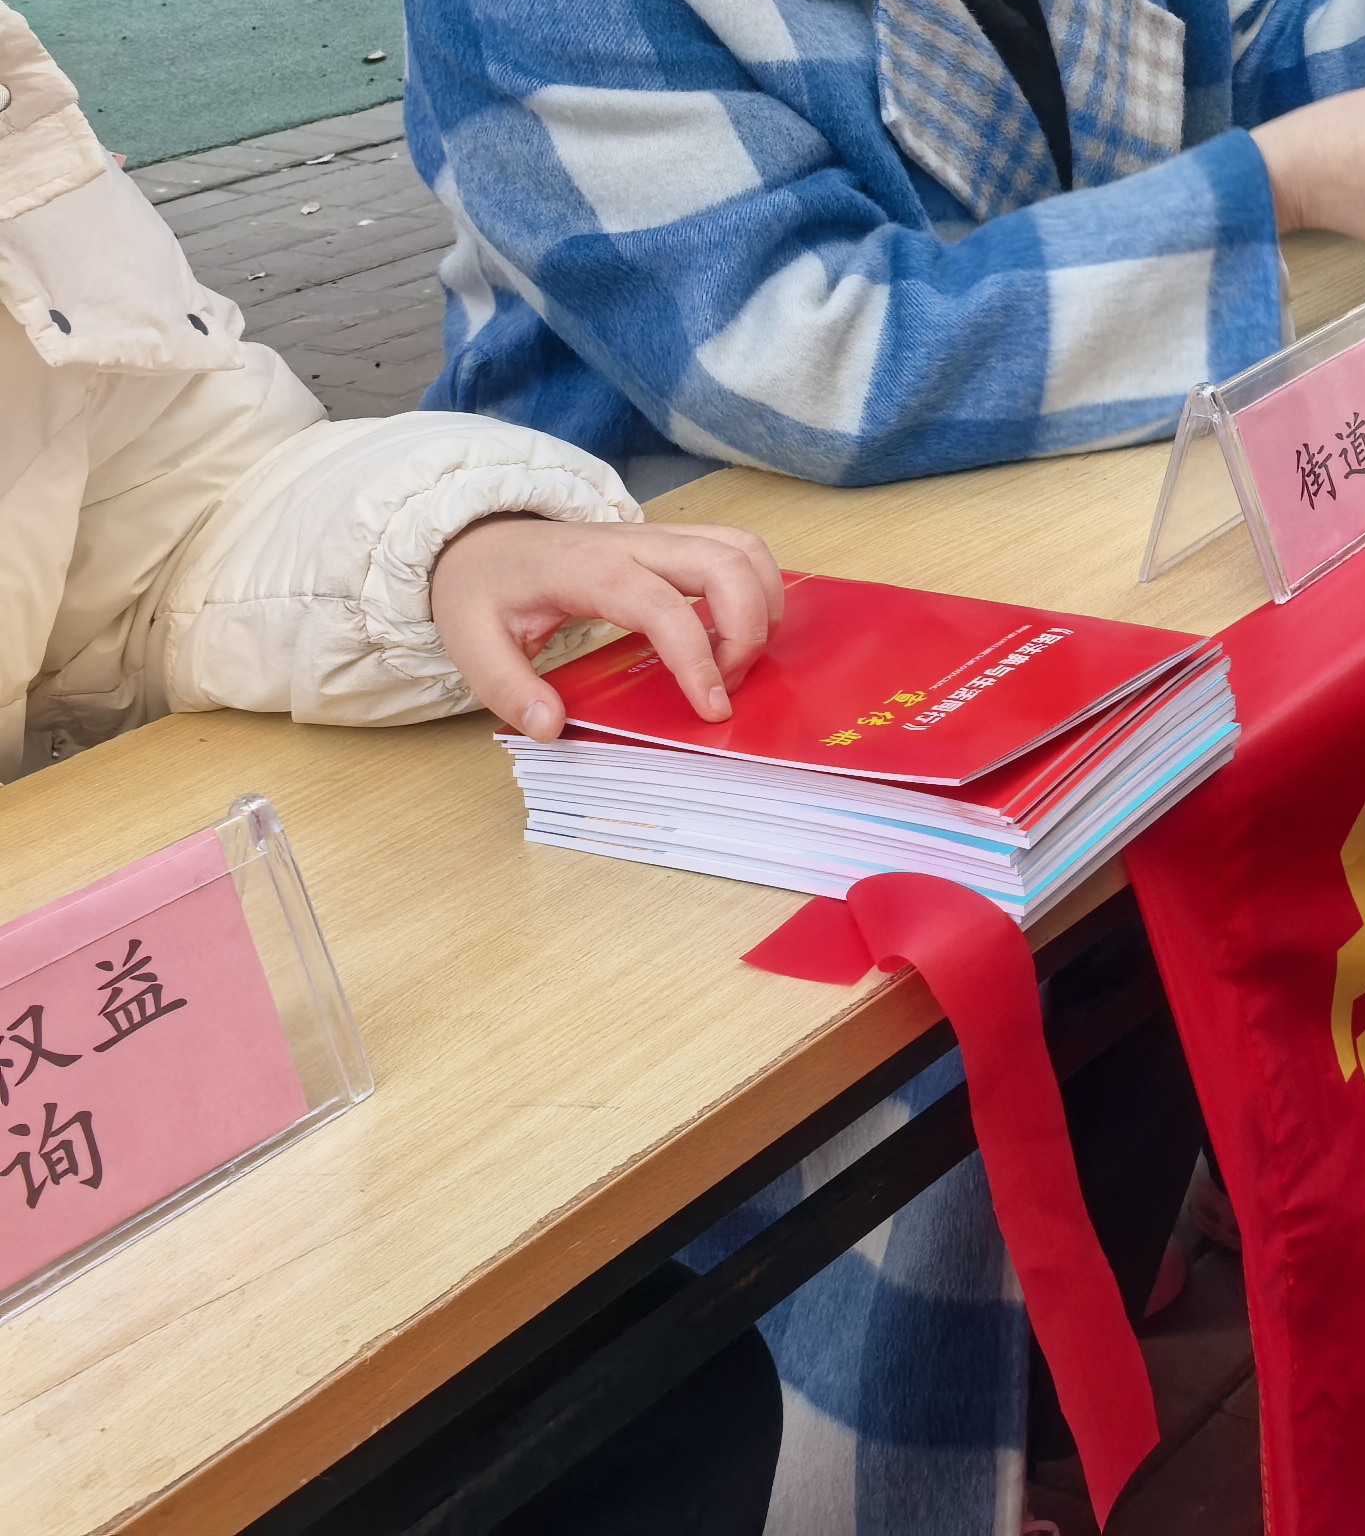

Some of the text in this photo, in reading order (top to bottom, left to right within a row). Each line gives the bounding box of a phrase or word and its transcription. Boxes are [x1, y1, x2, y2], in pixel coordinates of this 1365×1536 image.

[819, 688, 929, 748] 宣传册
[0, 938, 188, 1107] 权益
[0, 1102, 104, 1210] 询
